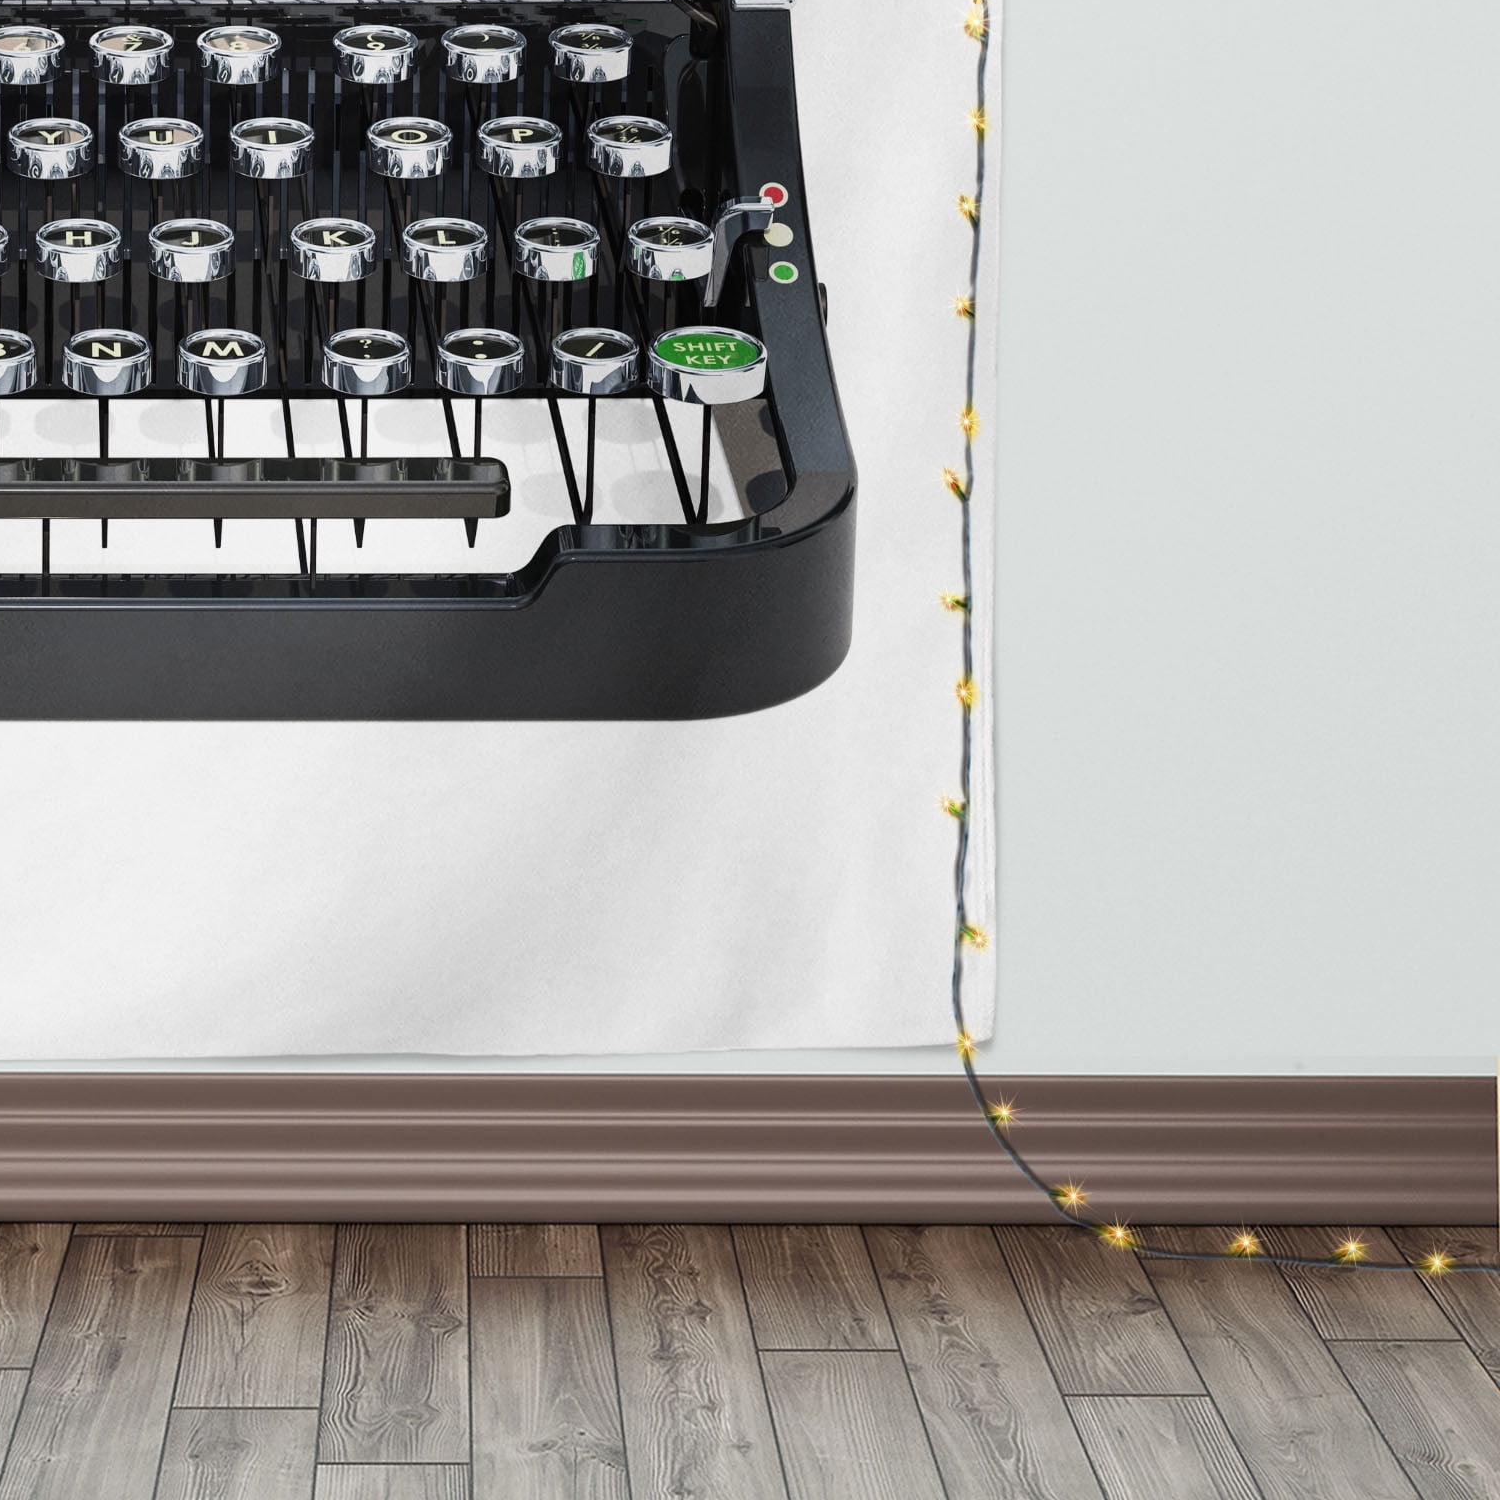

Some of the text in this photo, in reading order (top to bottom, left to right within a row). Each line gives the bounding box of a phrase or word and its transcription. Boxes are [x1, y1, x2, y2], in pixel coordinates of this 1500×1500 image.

[37, 130, 63, 144] Y
[149, 130, 173, 144] U
[267, 130, 277, 144] I
[391, 129, 428, 143] O
[512, 128, 534, 142] P
[65, 231, 92, 246] H
[181, 231, 199, 246] J
[322, 230, 350, 246] K
[436, 230, 457, 245] L
[91, 342, 122, 358] N
[202, 341, 245, 357] M
[673, 342, 738, 352] SHIFT
[686, 355, 731, 365] KEY
